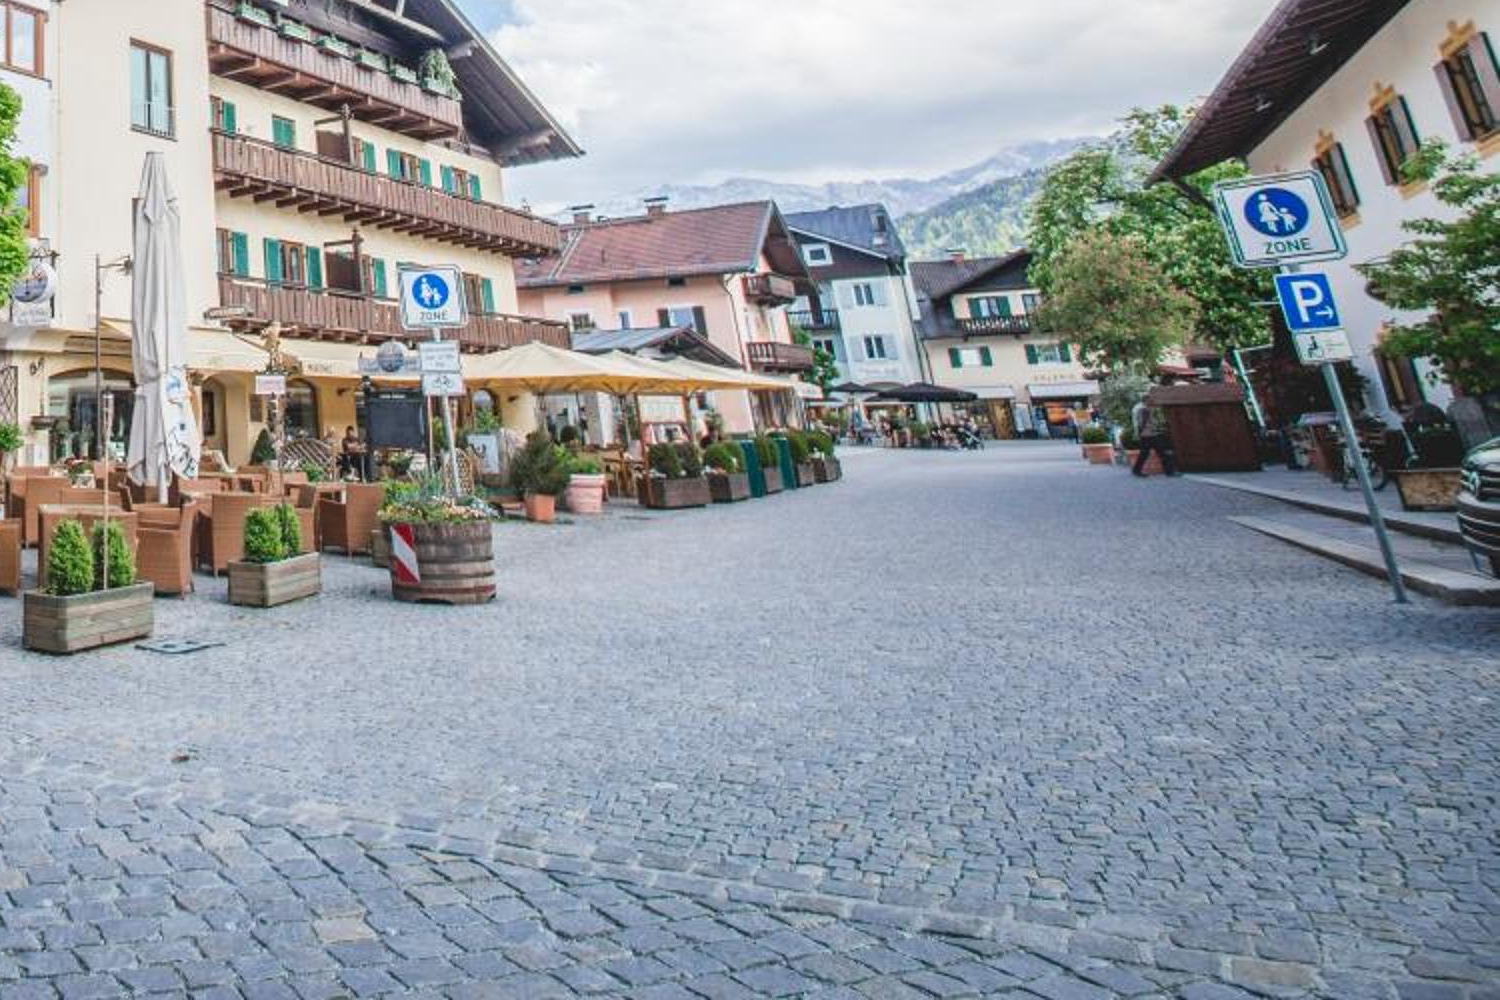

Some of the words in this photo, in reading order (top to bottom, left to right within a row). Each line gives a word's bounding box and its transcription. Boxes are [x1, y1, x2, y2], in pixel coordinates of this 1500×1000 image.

[1264, 237, 1312, 254] ZONE
[1290, 279, 1323, 323] P
[419, 309, 449, 321] ZONE
